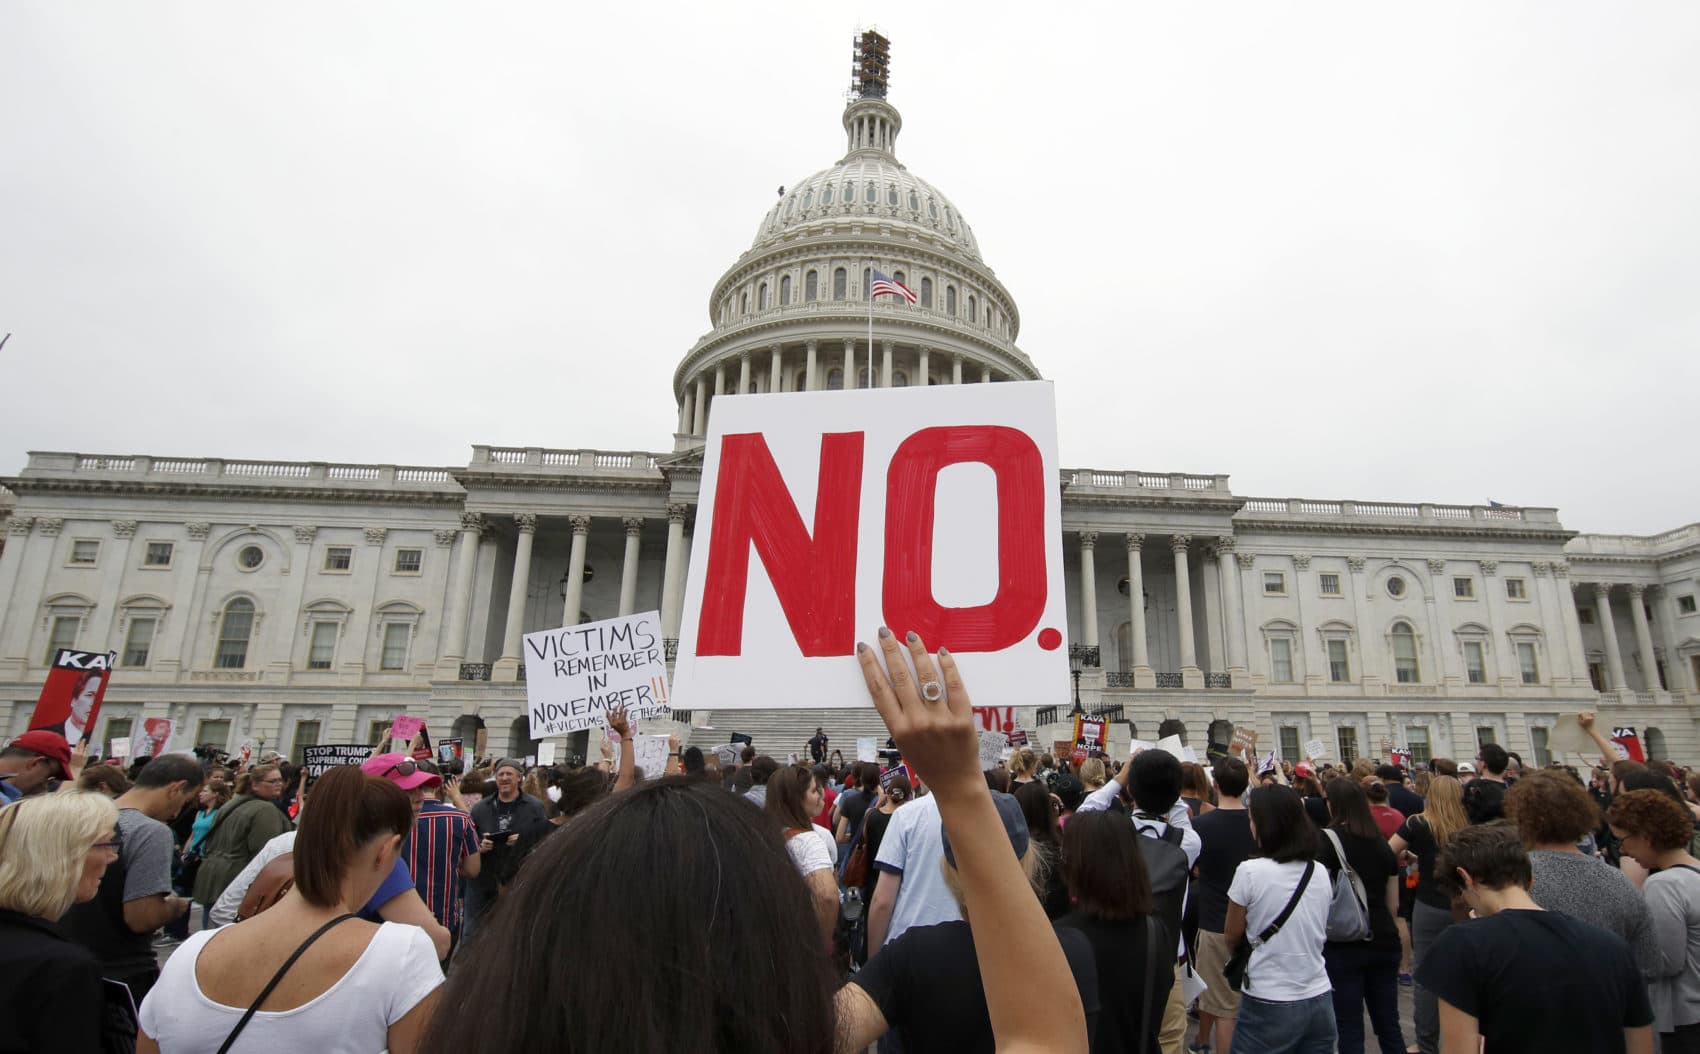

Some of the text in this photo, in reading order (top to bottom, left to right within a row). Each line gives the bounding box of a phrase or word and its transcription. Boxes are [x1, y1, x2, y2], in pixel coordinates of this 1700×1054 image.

[695, 425, 1062, 657] NO.
[527, 620, 655, 660] VICTIMS
[554, 648, 663, 677] REMEMBER
[587, 672, 607, 692] IN
[533, 676, 667, 730] NOVEMBER!!
[1081, 714, 1105, 723] KAVA
[306, 747, 333, 757] STOP
[1077, 743, 1102, 752] NOPE
[307, 756, 347, 765] SUPREME
